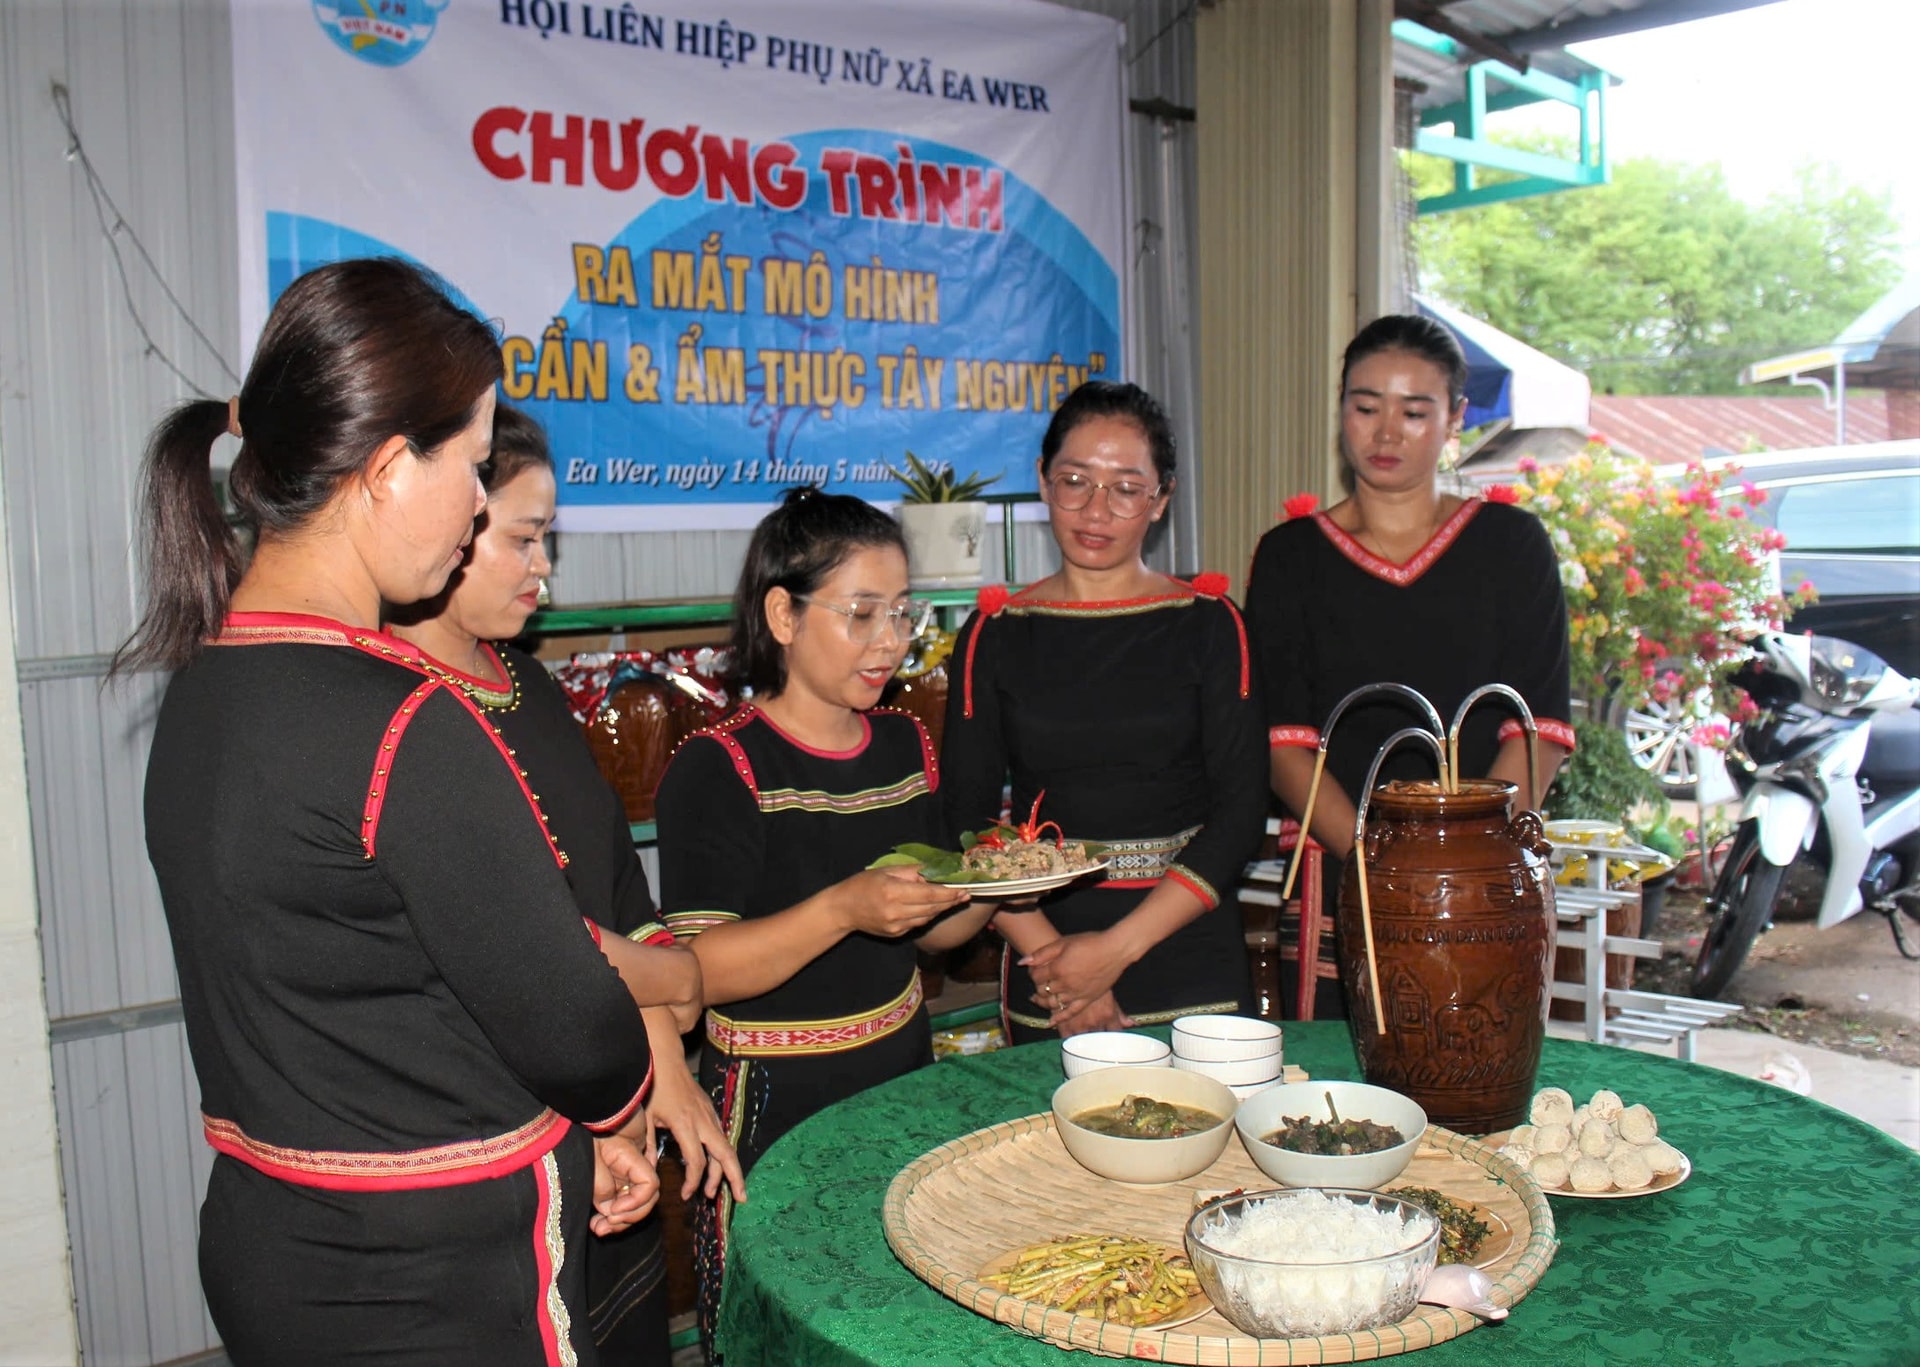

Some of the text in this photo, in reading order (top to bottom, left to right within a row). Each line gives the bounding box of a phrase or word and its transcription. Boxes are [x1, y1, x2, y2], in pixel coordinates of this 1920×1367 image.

[583, 3, 664, 49] LIÊN
[675, 20, 756, 70] HIỆP
[767, 36, 832, 85] PHỤ
[842, 48, 890, 87] NỮ
[897, 58, 934, 95] XÃ
[942, 70, 975, 103] EA
[983, 77, 1050, 112] WER
[472, 106, 1004, 233] CHƯƠNG TRÌNH
[572, 232, 940, 325] RA MẮT MÔ HÌNH
[500, 317, 608, 402] CẦN
[624, 342, 660, 402] &
[674, 323, 747, 405] ẨM
[758, 346, 866, 420] THỰC
[877, 345, 944, 410] TÂY
[566, 457, 598, 484] Ea
[605, 459, 660, 487] Wer,
[665, 459, 727, 490] ngày
[731, 458, 760, 483] 14
[763, 459, 830, 489] tháng
[833, 458, 848, 483] 5
[851, 459, 898, 483] năm
